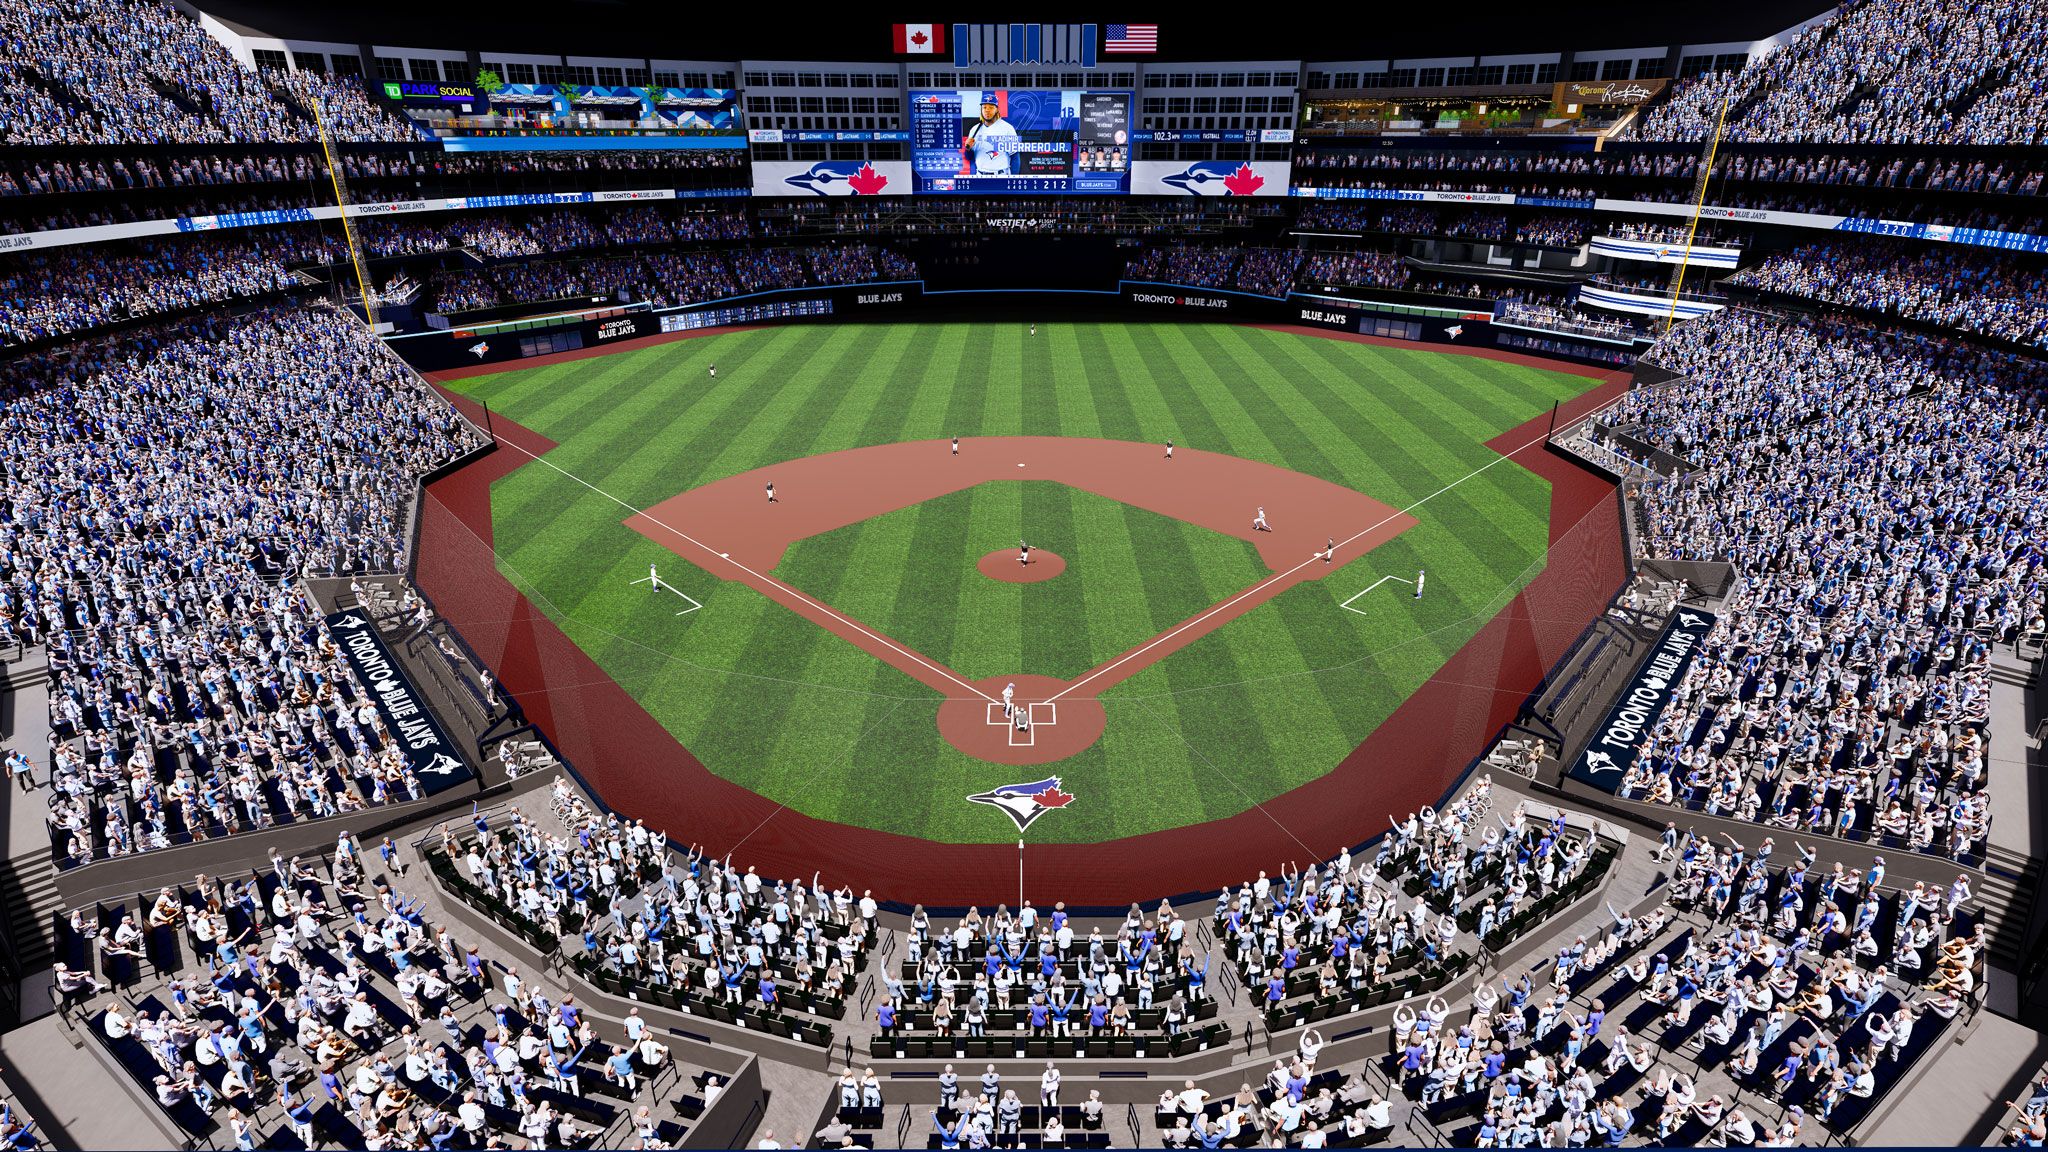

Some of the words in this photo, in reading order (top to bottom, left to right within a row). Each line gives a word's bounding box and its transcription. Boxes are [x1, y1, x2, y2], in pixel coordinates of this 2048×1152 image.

[384, 86, 400, 96] TD
[402, 84, 438, 94] PARK
[440, 88, 474, 96] SOCIAL
[1602, 83, 1652, 102] Rooftop
[1062, 107, 1075, 118] 1B
[1154, 132, 1171, 140] 102.3
[998, 142, 1050, 152] GUERRERO
[1052, 142, 1068, 152] JR.
[1044, 181, 1048, 189] 2
[1061, 181, 1066, 189] 2
[359, 205, 390, 213] TORONTO
[987, 219, 1026, 228] WESTJET
[1882, 225, 1888, 233] 3
[1892, 226, 1898, 234] 2
[1902, 226, 1907, 235] 0
[14, 237, 33, 247] JAYS
[858, 295, 879, 303] BLUE
[881, 293, 902, 302] JAYS
[1133, 294, 1175, 304] TORONTO
[1185, 297, 1205, 306] BLUE
[1206, 299, 1227, 308] JAYS
[1301, 310, 1323, 321] BLUE
[1324, 313, 1346, 324] JAYS
[605, 320, 631, 329] TORONTO
[598, 328, 616, 339] BLUE
[618, 325, 635, 335] JAYS
[345, 630, 393, 681] TORONTO
[1601, 687, 1660, 749] TORONTO
[1646, 653, 1682, 680] BLUE
[1664, 630, 1696, 656] JAYS
[380, 688, 419, 720] BLUE
[398, 718, 439, 749] JAYS
